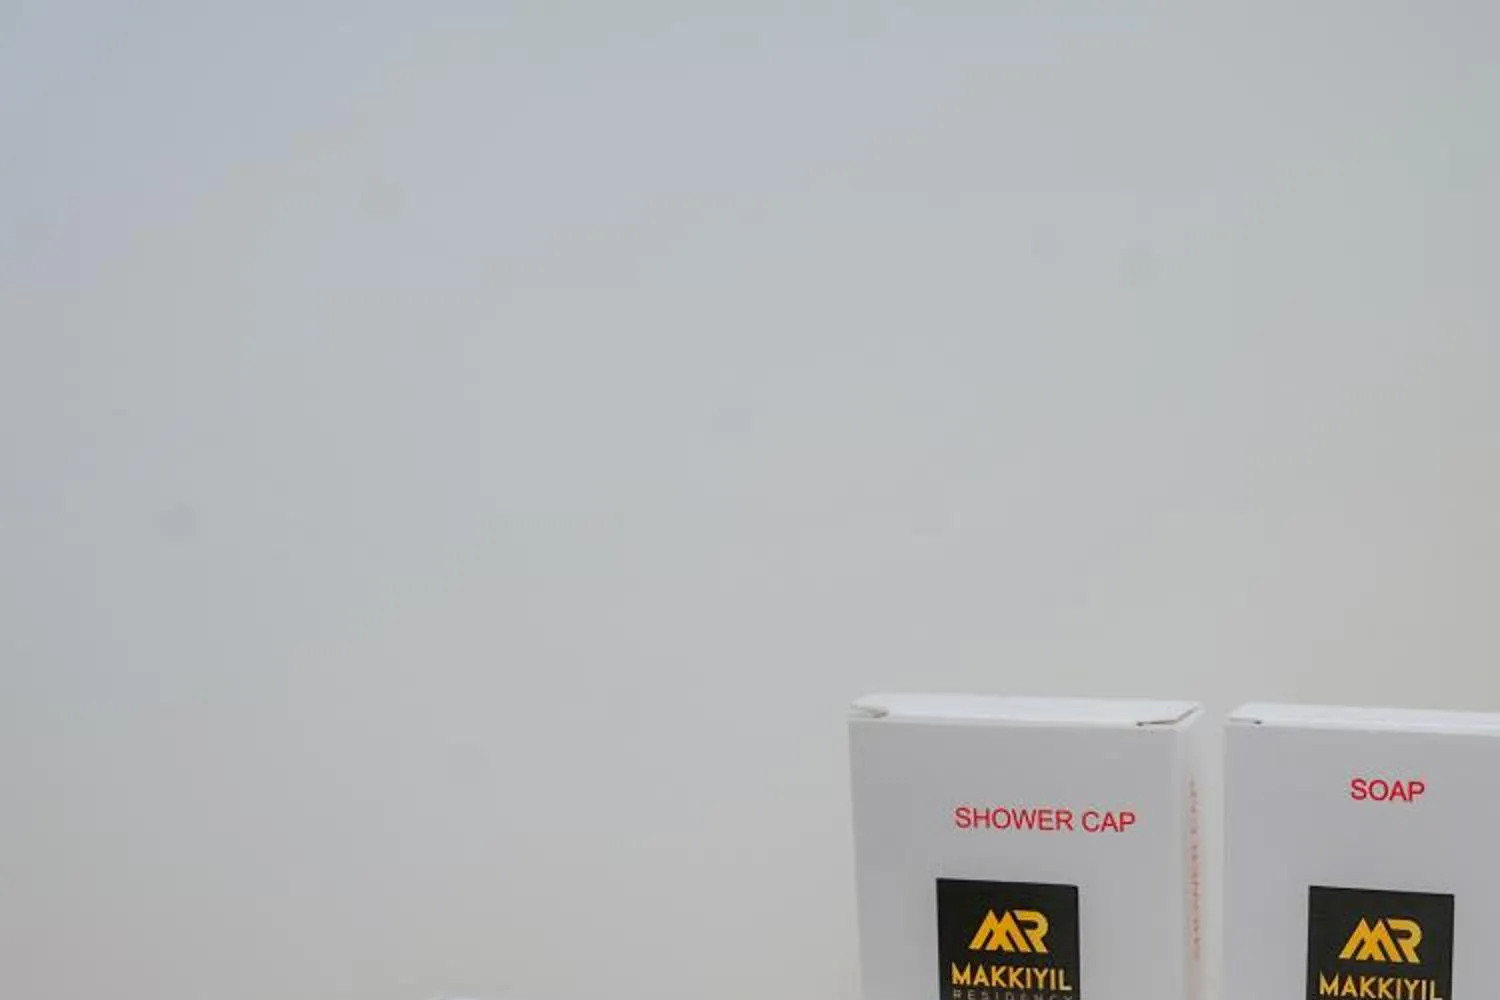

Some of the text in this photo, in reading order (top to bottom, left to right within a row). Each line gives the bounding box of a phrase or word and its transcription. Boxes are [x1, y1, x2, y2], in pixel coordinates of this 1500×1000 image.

[1351, 778, 1425, 802] SOAP
[955, 806, 1136, 833] SHOWER CAP
[951, 961, 1073, 991] MAKKIYIL
